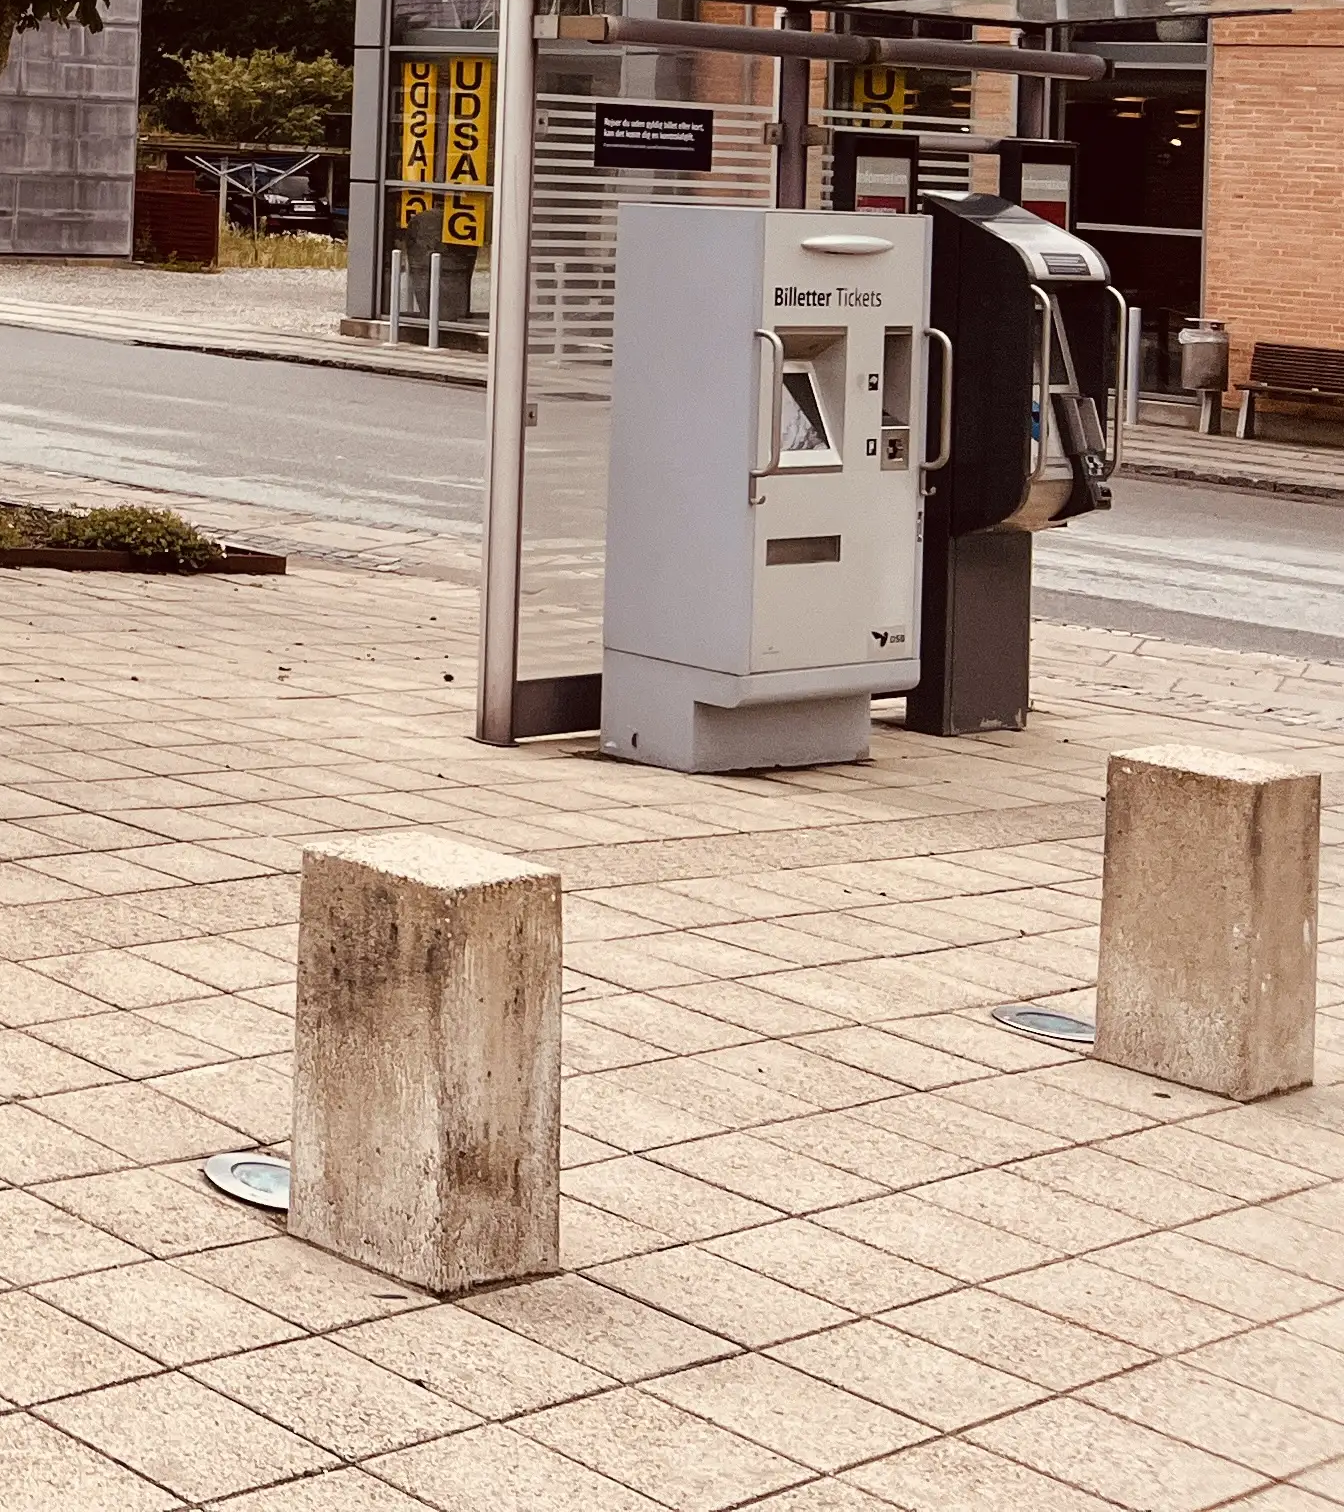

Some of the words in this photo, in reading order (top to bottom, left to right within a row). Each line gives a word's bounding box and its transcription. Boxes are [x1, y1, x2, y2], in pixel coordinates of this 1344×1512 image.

[447, 61, 483, 242] UDSALG
[774, 286, 832, 307] Billetter
[836, 287, 882, 308] Tickets
